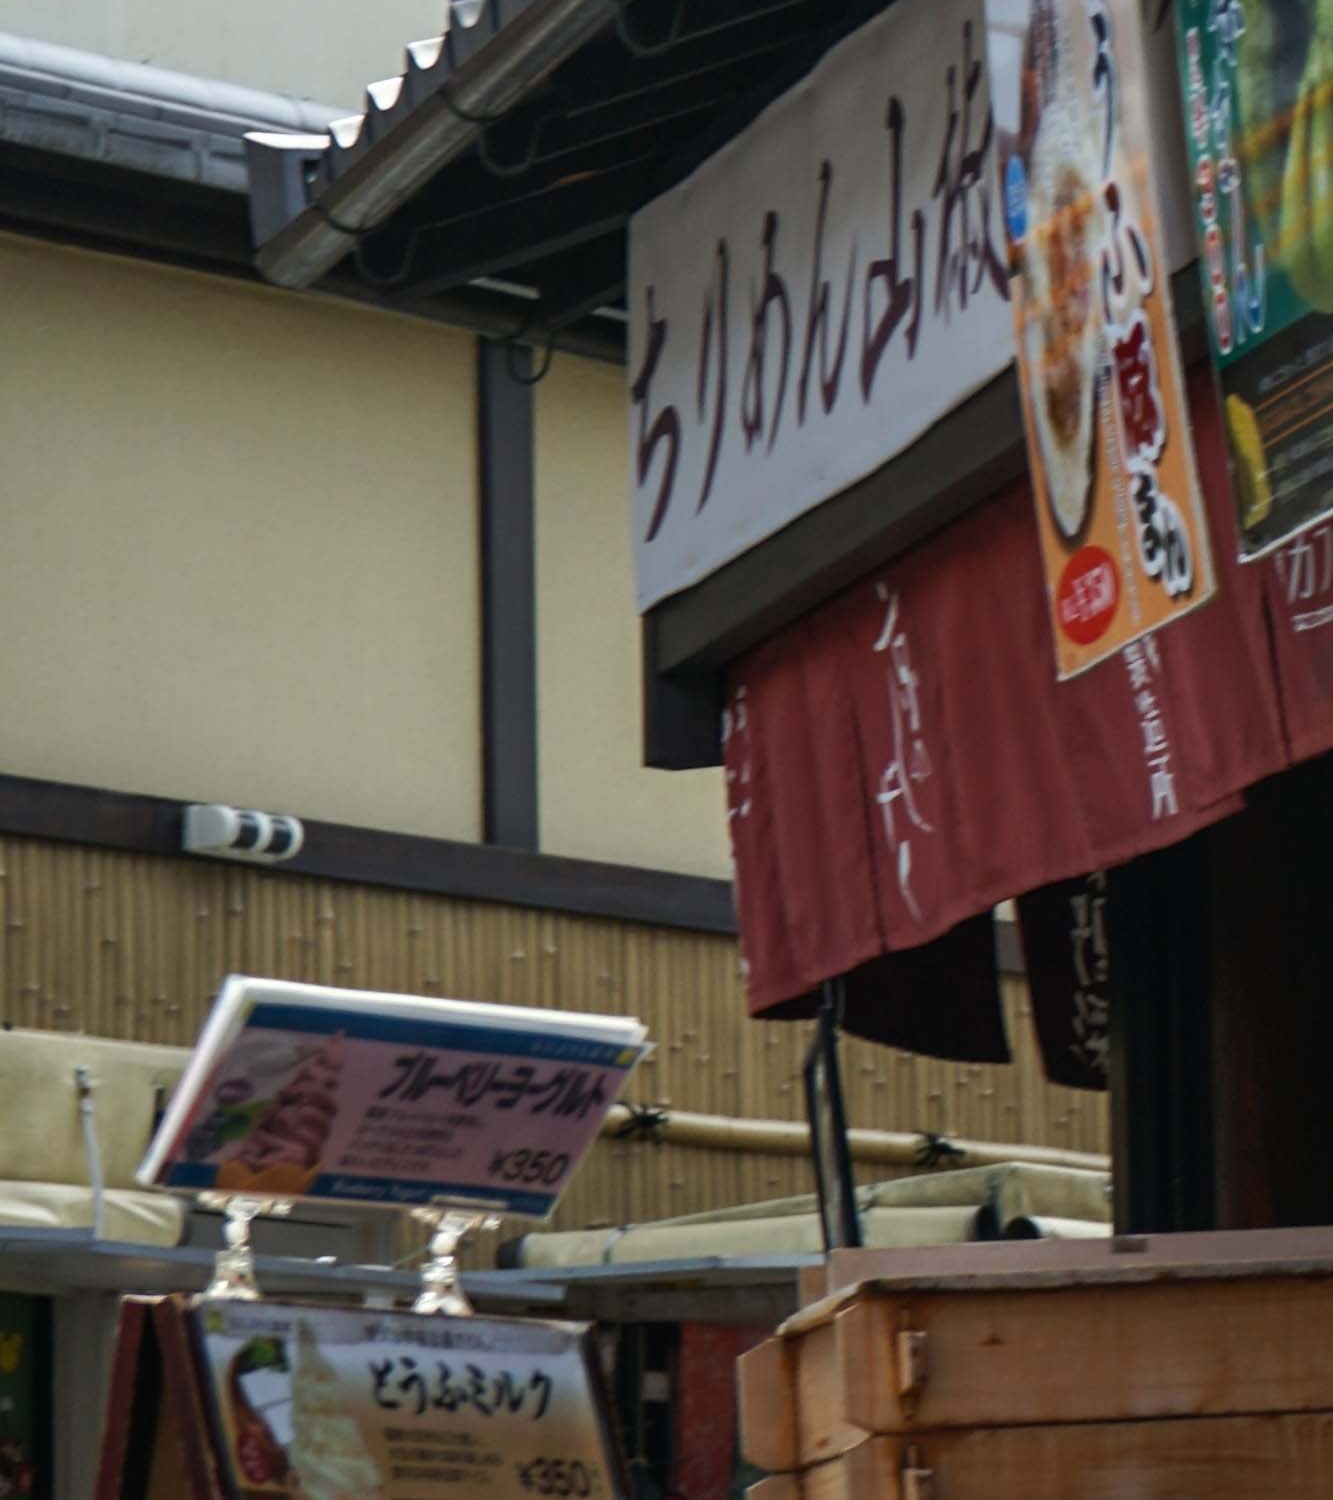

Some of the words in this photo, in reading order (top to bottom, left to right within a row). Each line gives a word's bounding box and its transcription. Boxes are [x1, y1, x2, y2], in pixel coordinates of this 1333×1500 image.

[379, 1052, 606, 1120] ブルーベリーヨーグルト
[488, 1147, 570, 1185] ¥350
[370, 1357, 553, 1420] とうふミルク
[516, 1456, 590, 1499] ¥350
